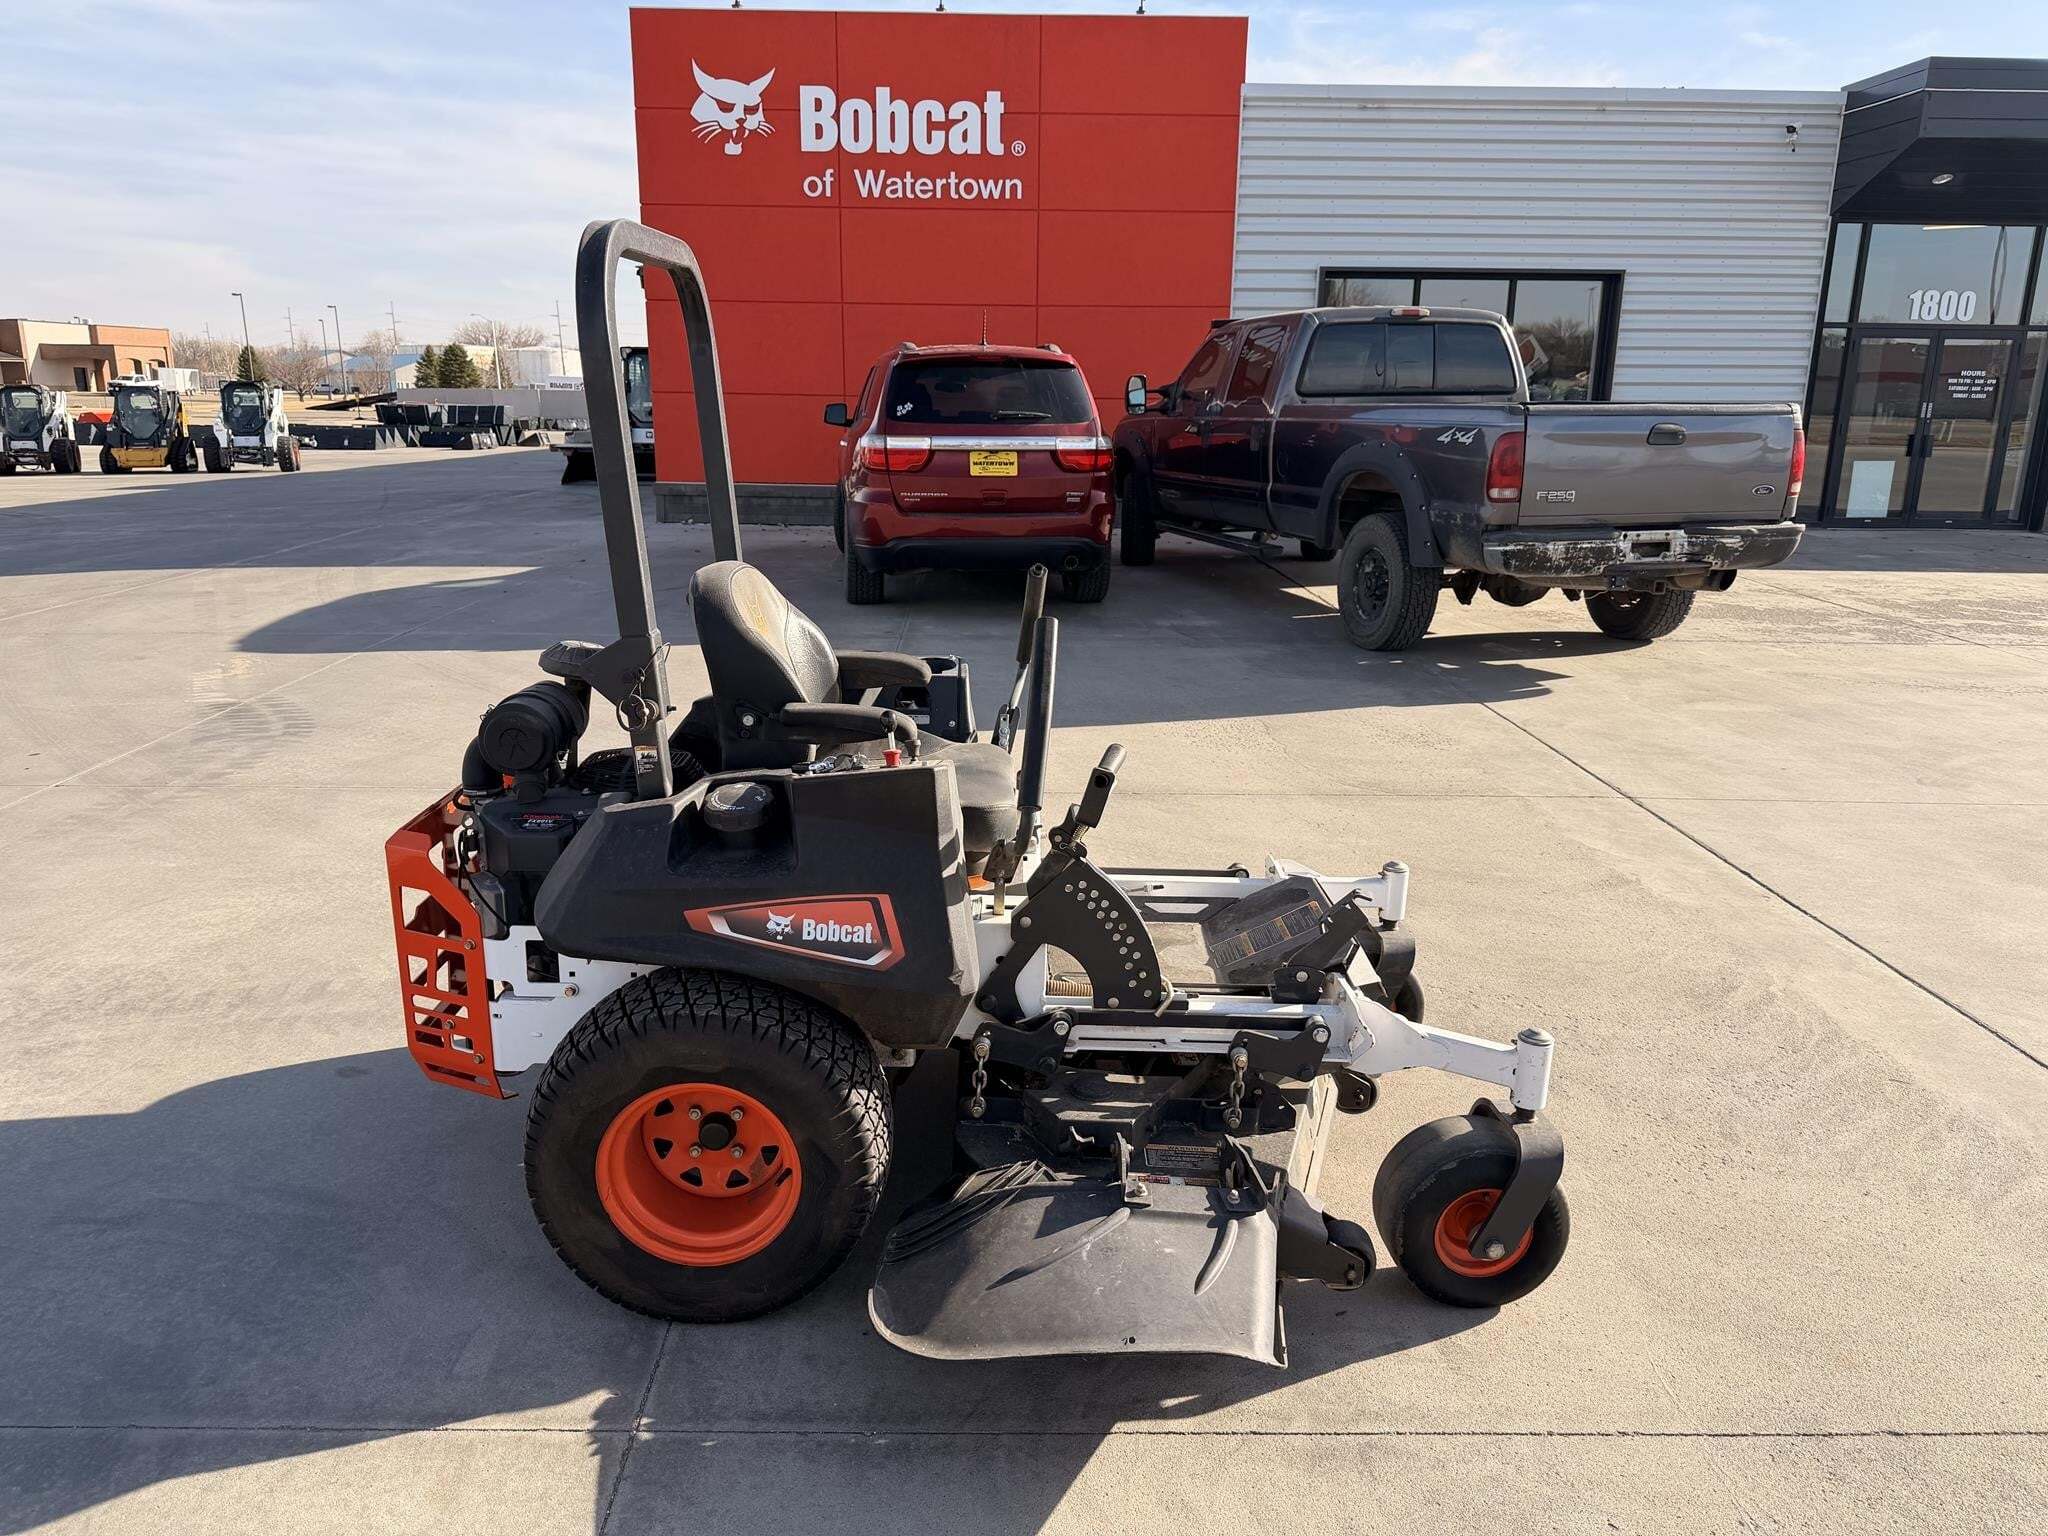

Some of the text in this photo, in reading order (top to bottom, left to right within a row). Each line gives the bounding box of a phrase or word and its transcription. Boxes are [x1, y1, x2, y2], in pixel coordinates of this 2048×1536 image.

[799, 85, 1005, 156] Bobcat
[803, 169, 1023, 200] of Watertown
[1909, 289, 1977, 322] 1800
[802, 918, 873, 944] Bobcat
